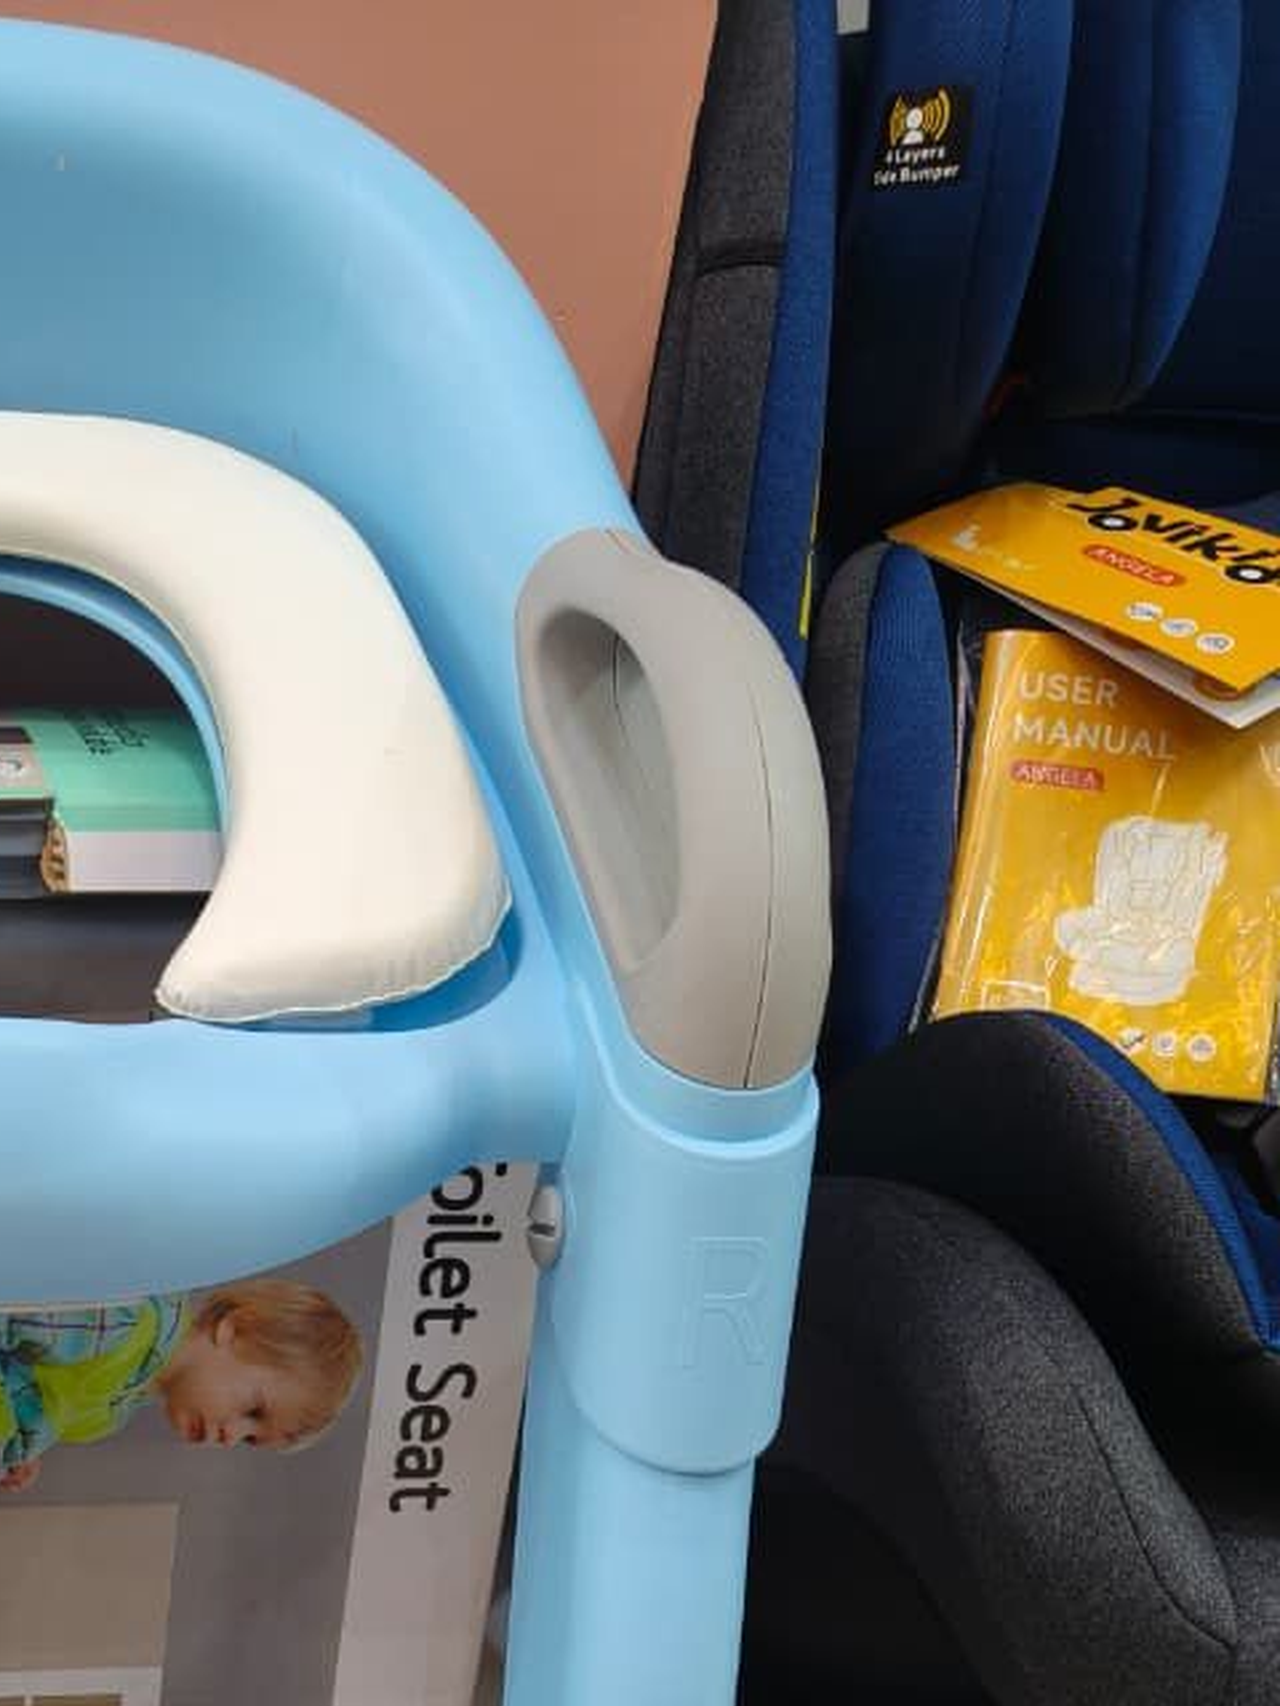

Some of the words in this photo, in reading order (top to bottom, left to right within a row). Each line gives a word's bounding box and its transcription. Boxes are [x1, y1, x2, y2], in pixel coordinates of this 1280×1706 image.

[894, 146, 945, 165] Layers
[900, 164, 960, 184] Bumper
[1086, 548, 1176, 585] ANGELA
[1021, 671, 1119, 707] USER
[1013, 711, 1176, 761] MANUAL
[1017, 762, 1097, 788] ANGELA
[414, 1161, 508, 1337] oilet
[681, 1235, 769, 1368] R
[388, 1362, 478, 1514] Seat
